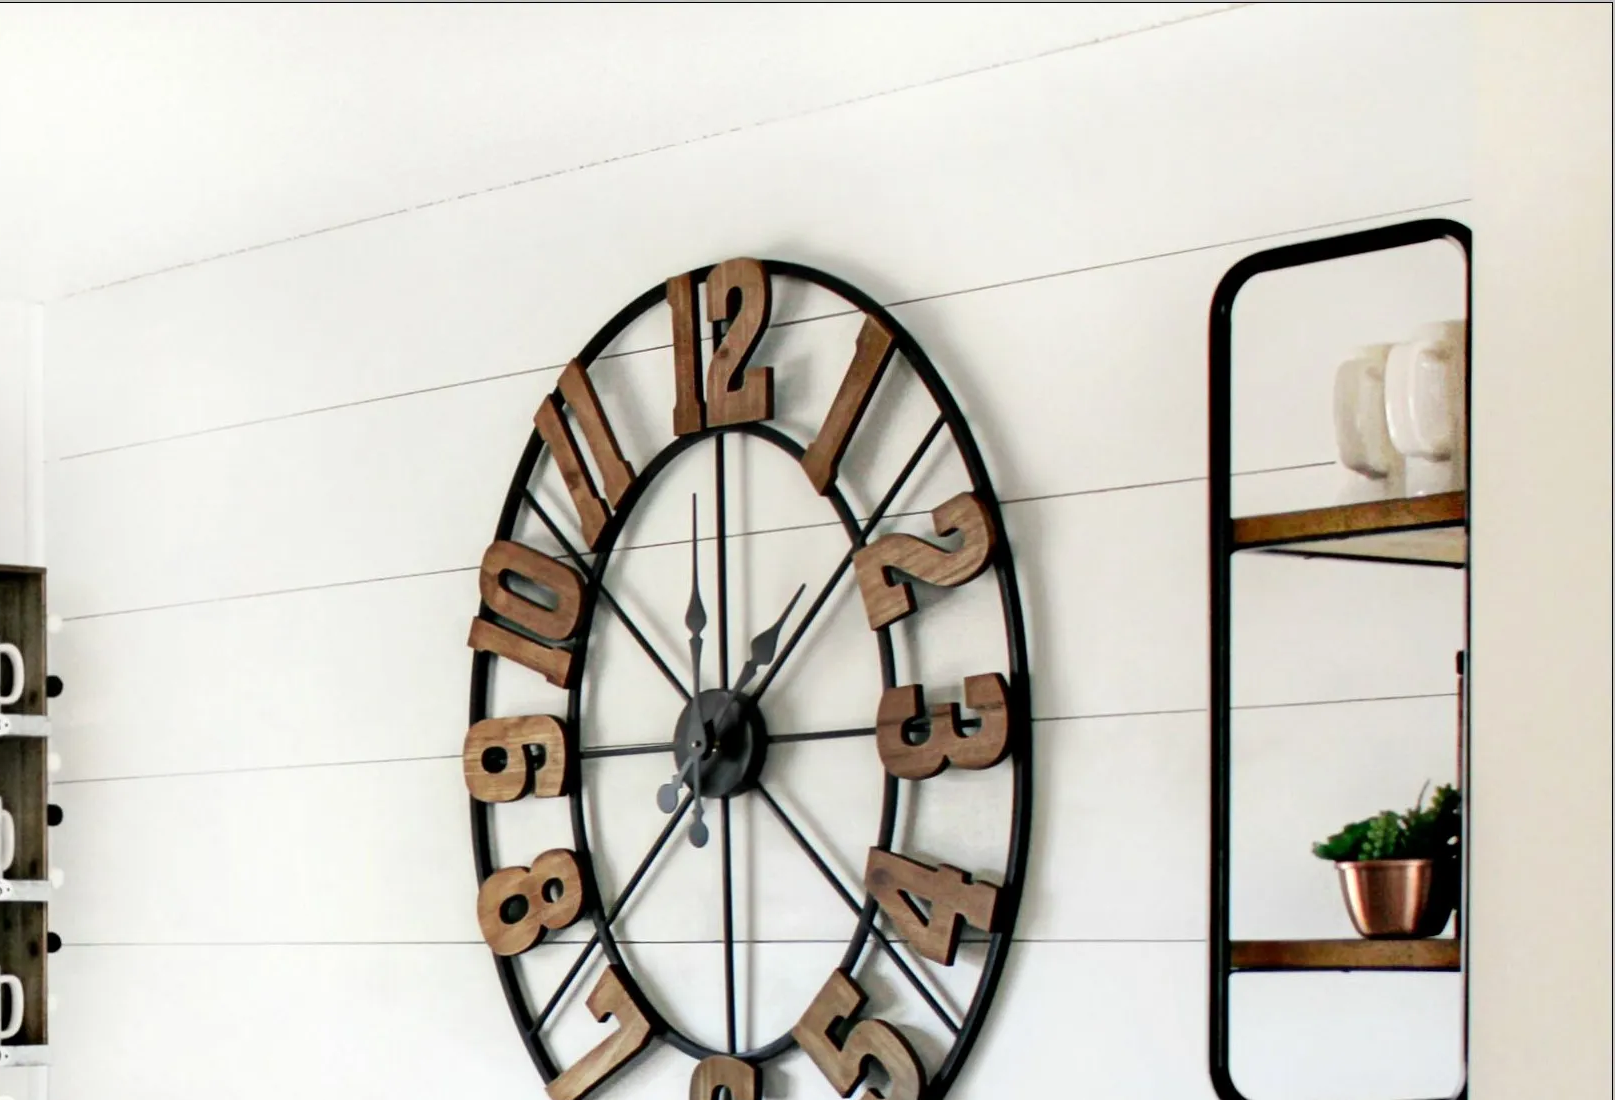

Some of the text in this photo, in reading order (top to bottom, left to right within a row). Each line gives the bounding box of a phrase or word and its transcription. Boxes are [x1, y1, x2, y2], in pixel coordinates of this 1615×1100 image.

[665, 257, 776, 437] 12
[800, 307, 898, 497] 1
[532, 357, 637, 552] 11
[467, 539, 588, 690] 10
[852, 490, 998, 632] 2
[876, 671, 1010, 782] 3
[476, 846, 585, 958] 8
[865, 844, 1006, 967] 4
